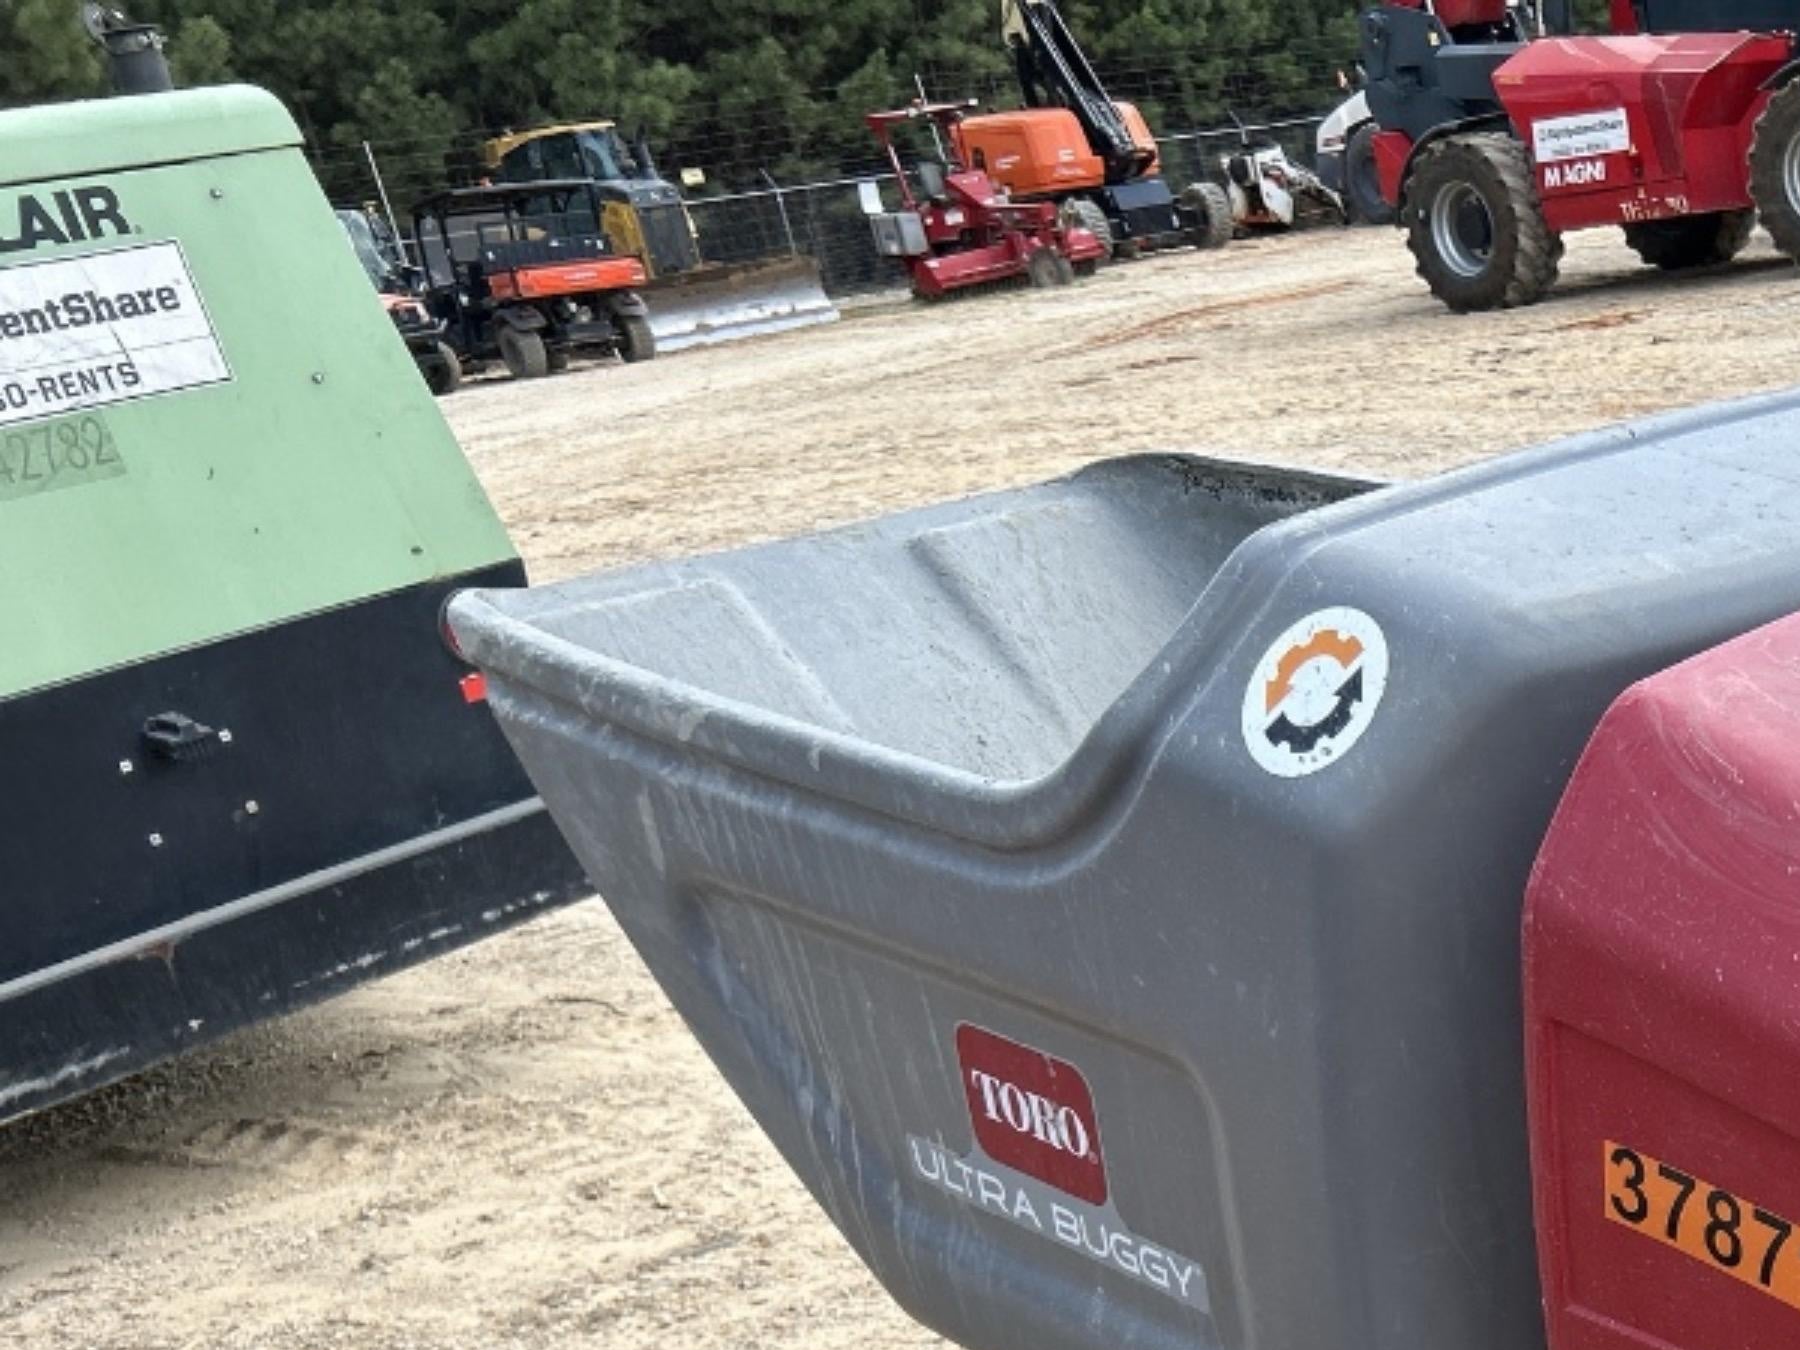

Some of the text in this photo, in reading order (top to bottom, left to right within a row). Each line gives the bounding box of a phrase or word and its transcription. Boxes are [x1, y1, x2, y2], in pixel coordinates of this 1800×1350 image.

[1544, 160, 1606, 188] MAGNI
[0, 284, 181, 340] entShare
[971, 1069, 1090, 1158] TORO
[909, 1138, 1194, 1297] ULTRA BUGGY
